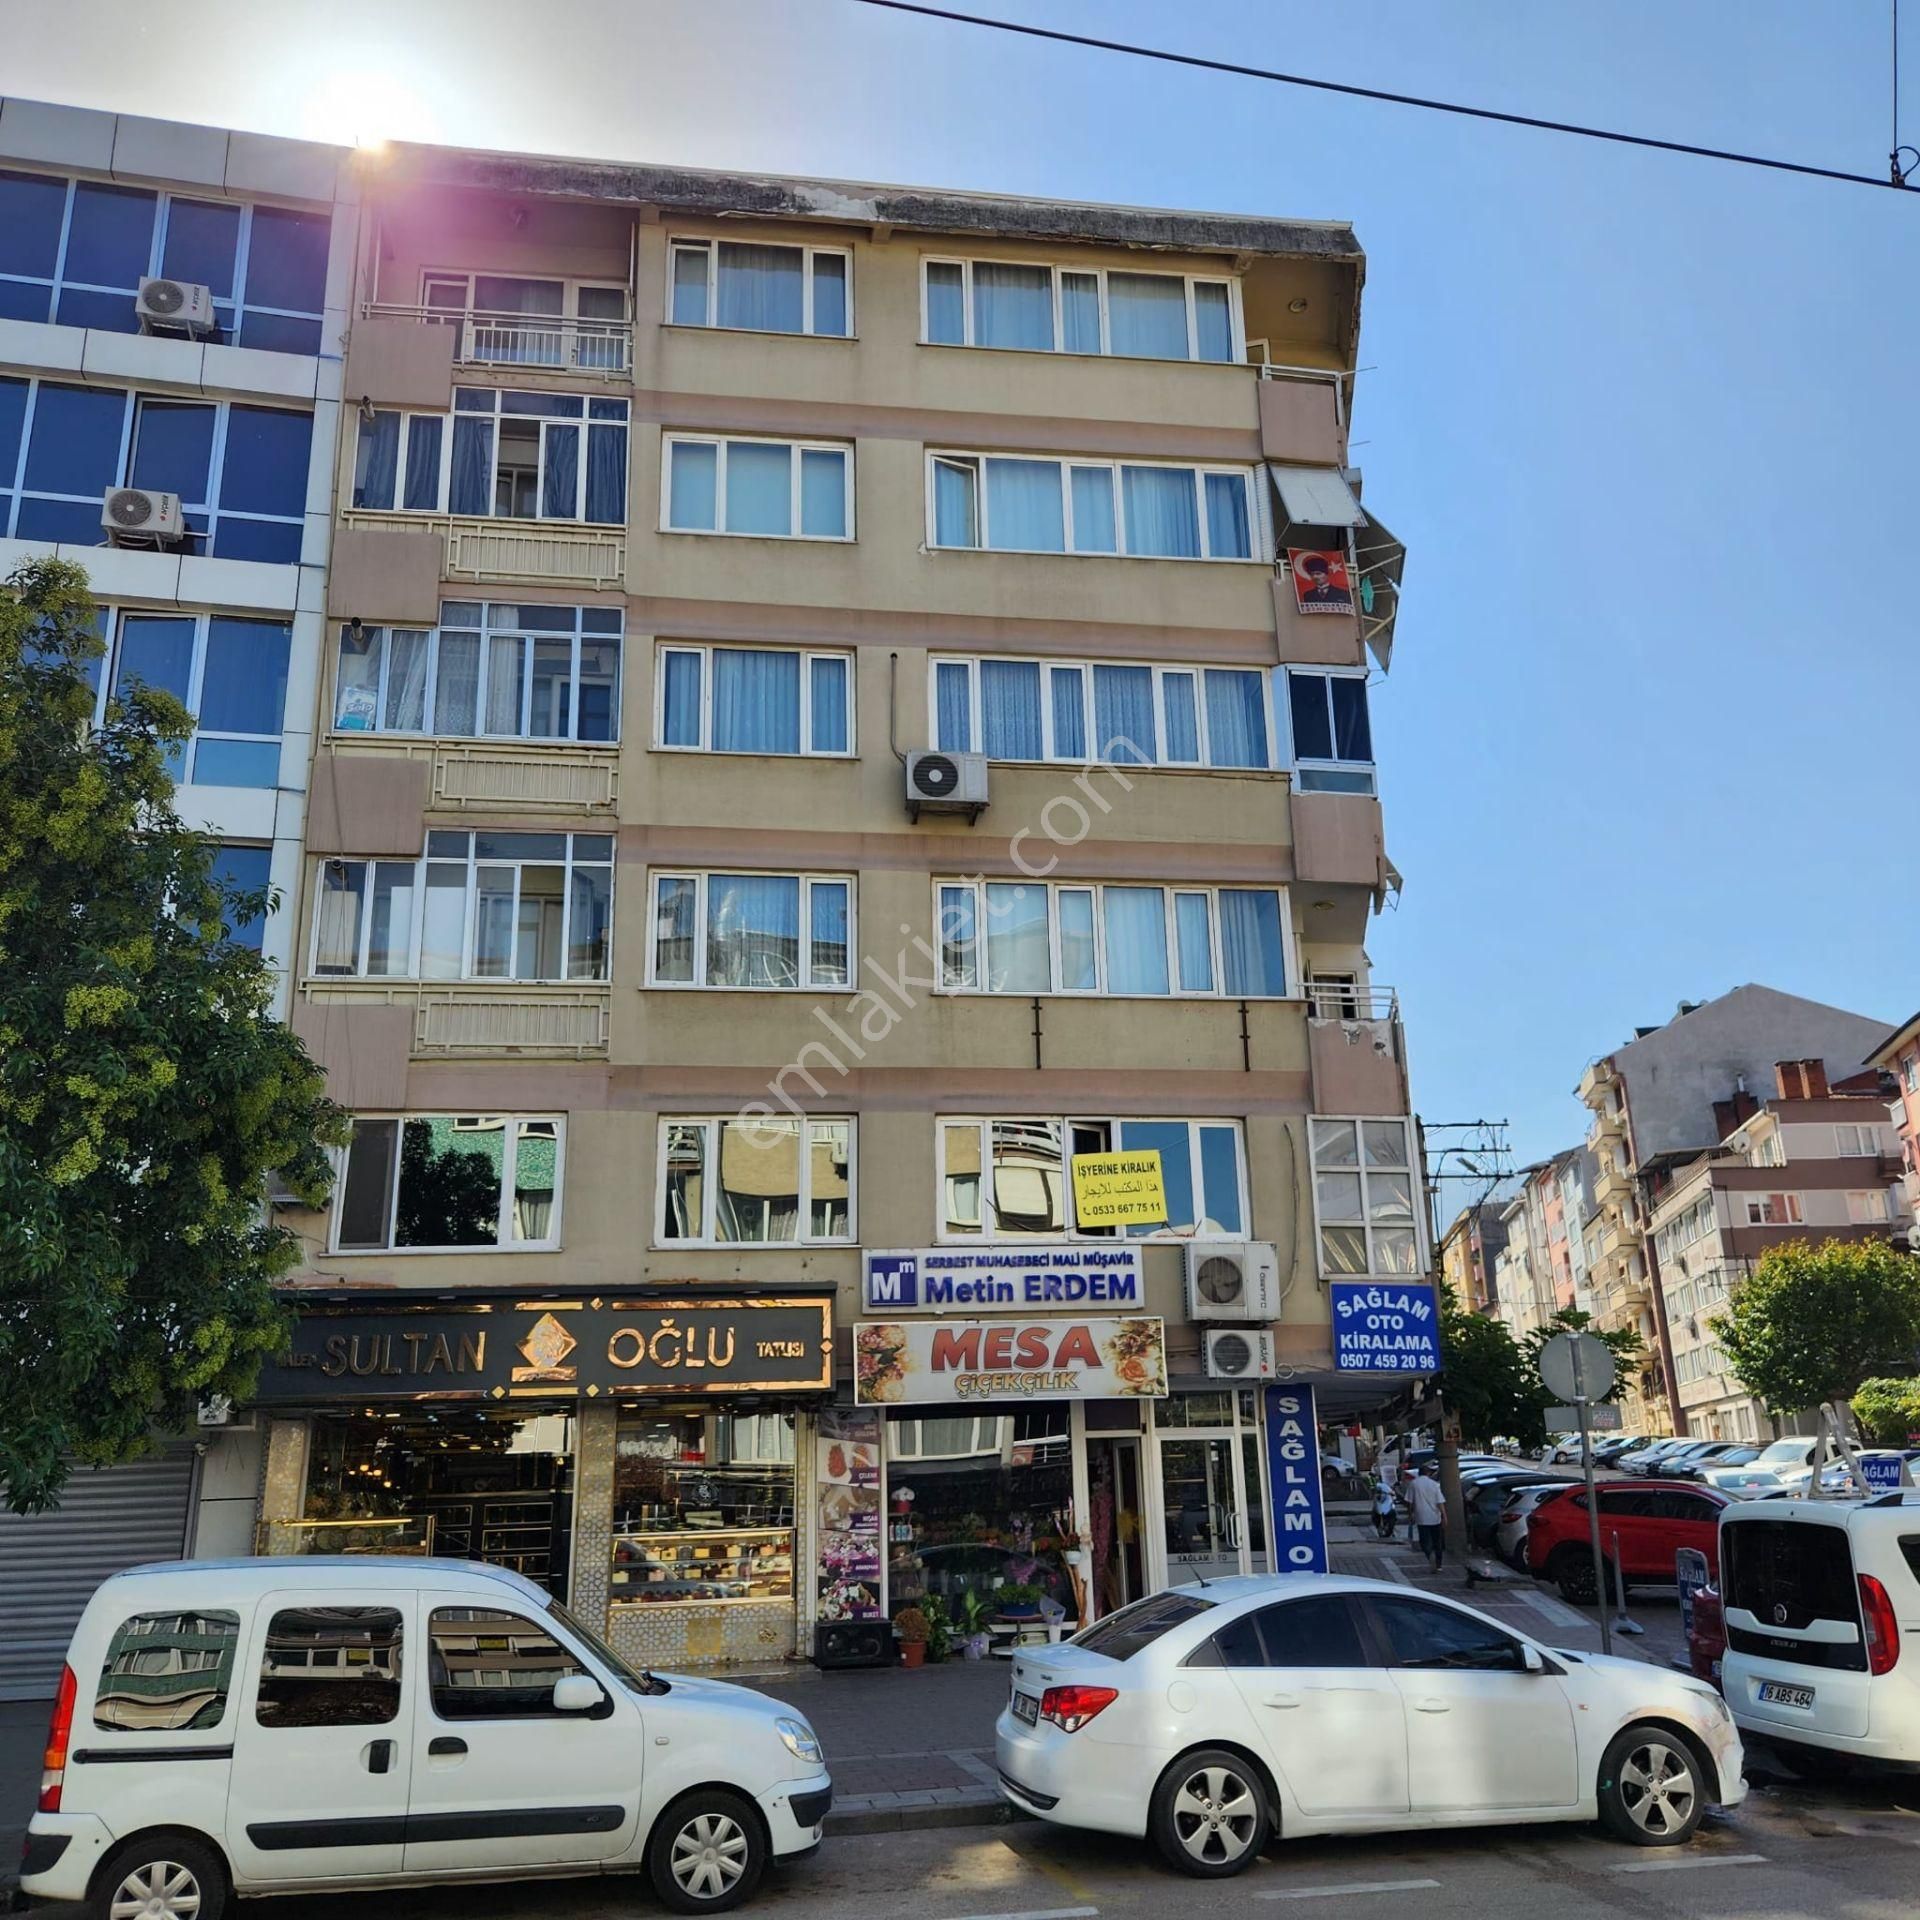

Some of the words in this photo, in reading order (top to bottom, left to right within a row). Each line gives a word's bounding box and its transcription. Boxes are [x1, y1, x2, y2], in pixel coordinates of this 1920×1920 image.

[1077, 1162, 1119, 1179] İŞYERİNE
[1121, 1161, 1156, 1175] KİRALIK
[1093, 1204, 1115, 1216] 0533
[1117, 1203, 1134, 1214] 667
[1137, 1202, 1148, 1213] 75
[1150, 1202, 1161, 1212] 11
[925, 1256, 974, 1269] SERBEST
[975, 1252, 1050, 1269] MUHASEBECİ
[1052, 1252, 1080, 1267] MALİ
[1083, 1251, 1134, 1269] MÜŞAVİR
[925, 1275, 1014, 1304] Metin
[1023, 1273, 1136, 1303] ERDEM
[1336, 1287, 1431, 1322] SAĞLAM
[1366, 1314, 1404, 1330] OTO
[321, 1331, 486, 1377] SULTAN
[607, 1318, 735, 1368] OĞLU
[931, 1326, 1103, 1372] MESA
[1340, 1331, 1433, 1350] KİRALAMA
[1340, 1354, 1371, 1367] 0507
[1374, 1354, 1397, 1368] 459
[1401, 1355, 1416, 1368] 20
[1420, 1355, 1435, 1369] 96
[1278, 1397, 1313, 1532] SAĞLAM
[1863, 1464, 1899, 1479] AĞLAM
[1765, 1685, 1774, 1699] 16
[1775, 1688, 1793, 1703] ABS
[1794, 1691, 1811, 1706] 464
